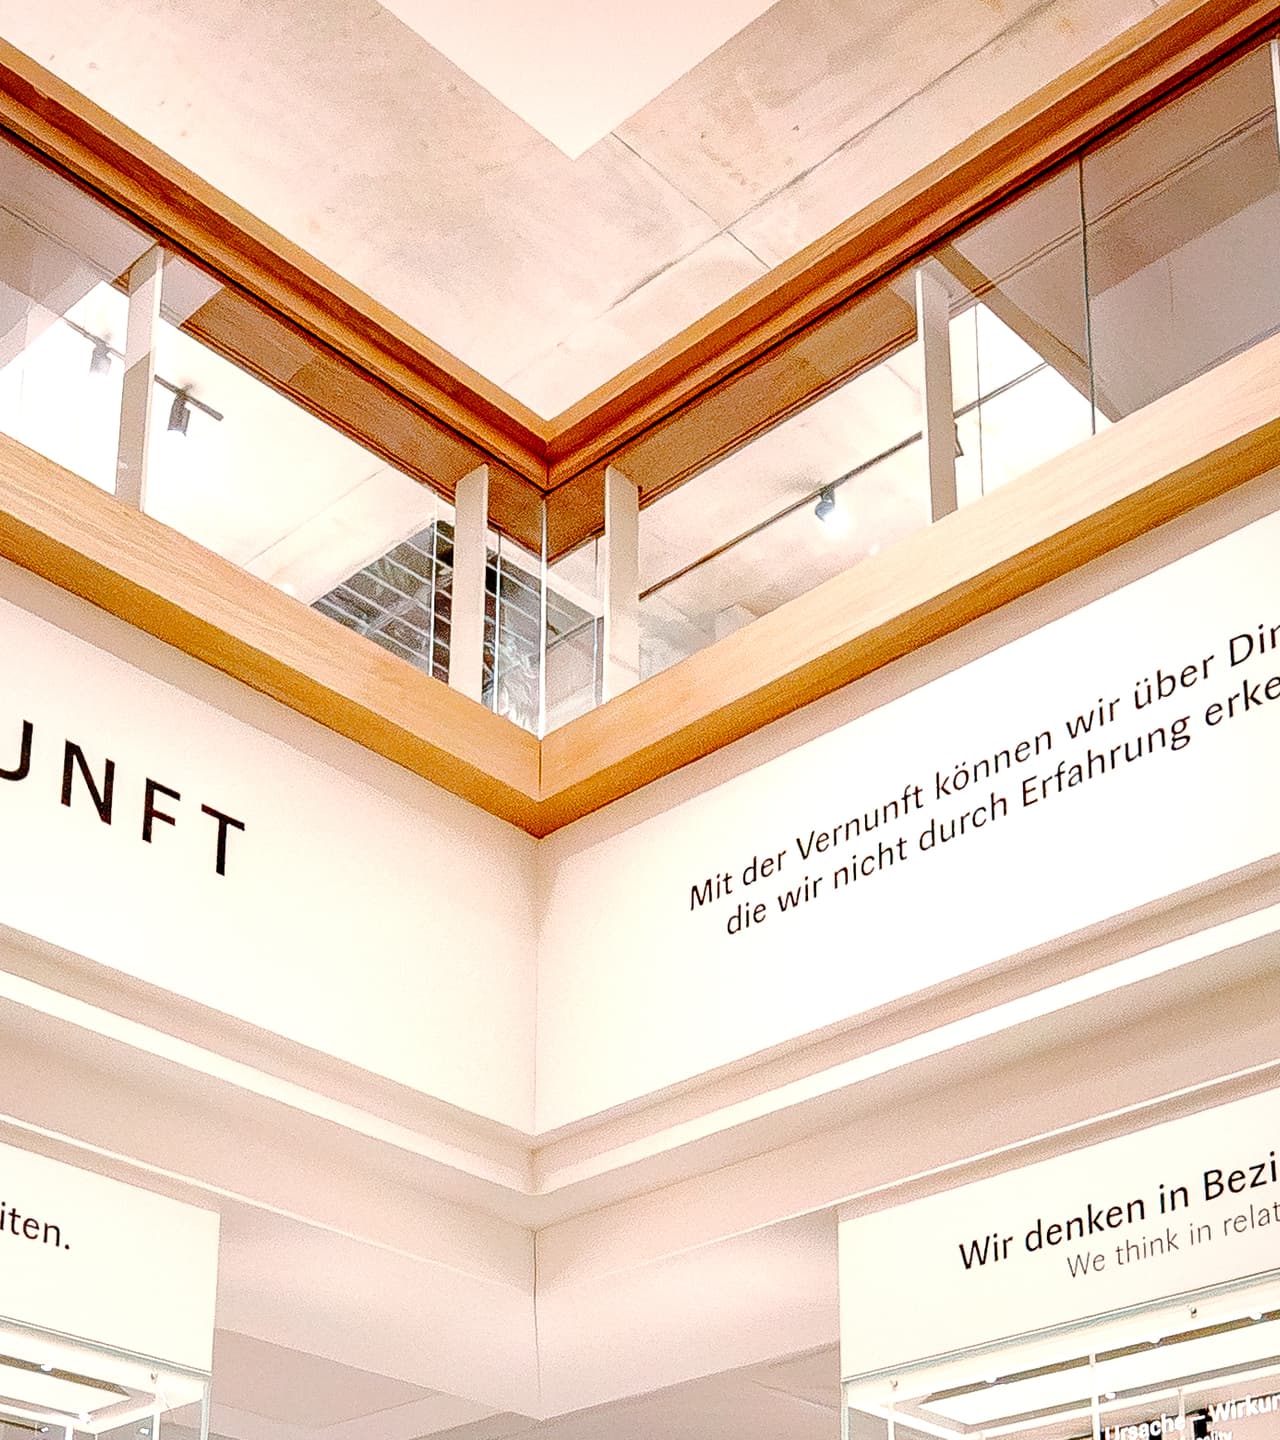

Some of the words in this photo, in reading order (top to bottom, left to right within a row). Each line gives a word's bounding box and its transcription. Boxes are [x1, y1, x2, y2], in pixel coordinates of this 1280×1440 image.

[688, 866, 734, 912] Mit
[739, 846, 788, 894] der
[795, 783, 926, 862] Vernunft
[932, 727, 1055, 798] können
[1065, 692, 1122, 744] wir
[1132, 649, 1216, 712] über
[724, 890, 770, 937] die
[775, 871, 826, 916] wir
[831, 836, 910, 890] nicht
[917, 789, 1010, 853] durch
[1020, 711, 1194, 811] Erfahrung
[958, 1227, 1016, 1274] Wir
[1023, 1197, 1148, 1256] denken
[1158, 1175, 1191, 1215] in
[1064, 1247, 1108, 1279] We
[1113, 1223, 1181, 1267] think
[1188, 1216, 1214, 1249] in
